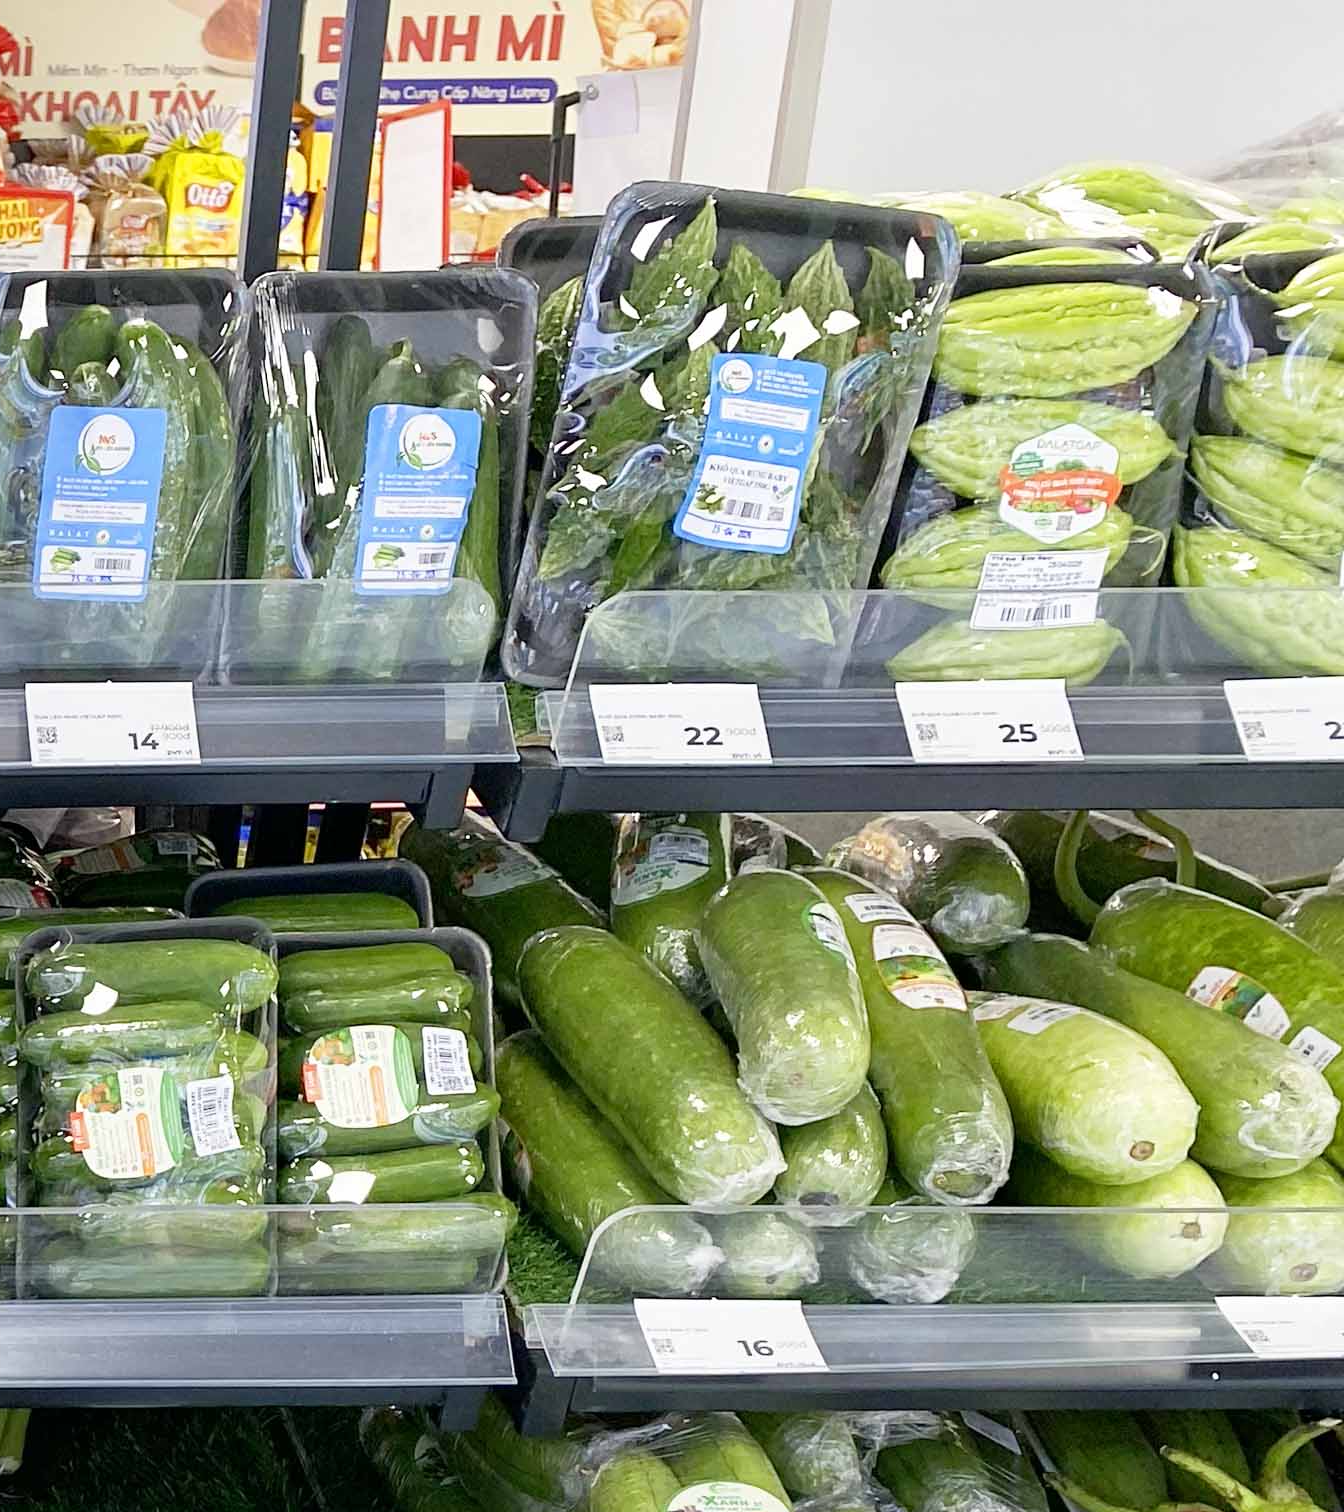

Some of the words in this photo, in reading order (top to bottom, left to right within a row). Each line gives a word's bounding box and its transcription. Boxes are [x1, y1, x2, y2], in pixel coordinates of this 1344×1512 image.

[318, 15, 478, 63] BNH
[497, 3, 566, 62] MÌ
[18, 89, 139, 123] KHOAI
[129, 733, 159, 750] 14
[685, 727, 723, 745] 22
[999, 724, 1037, 742] 25
[738, 1341, 773, 1356] 16
